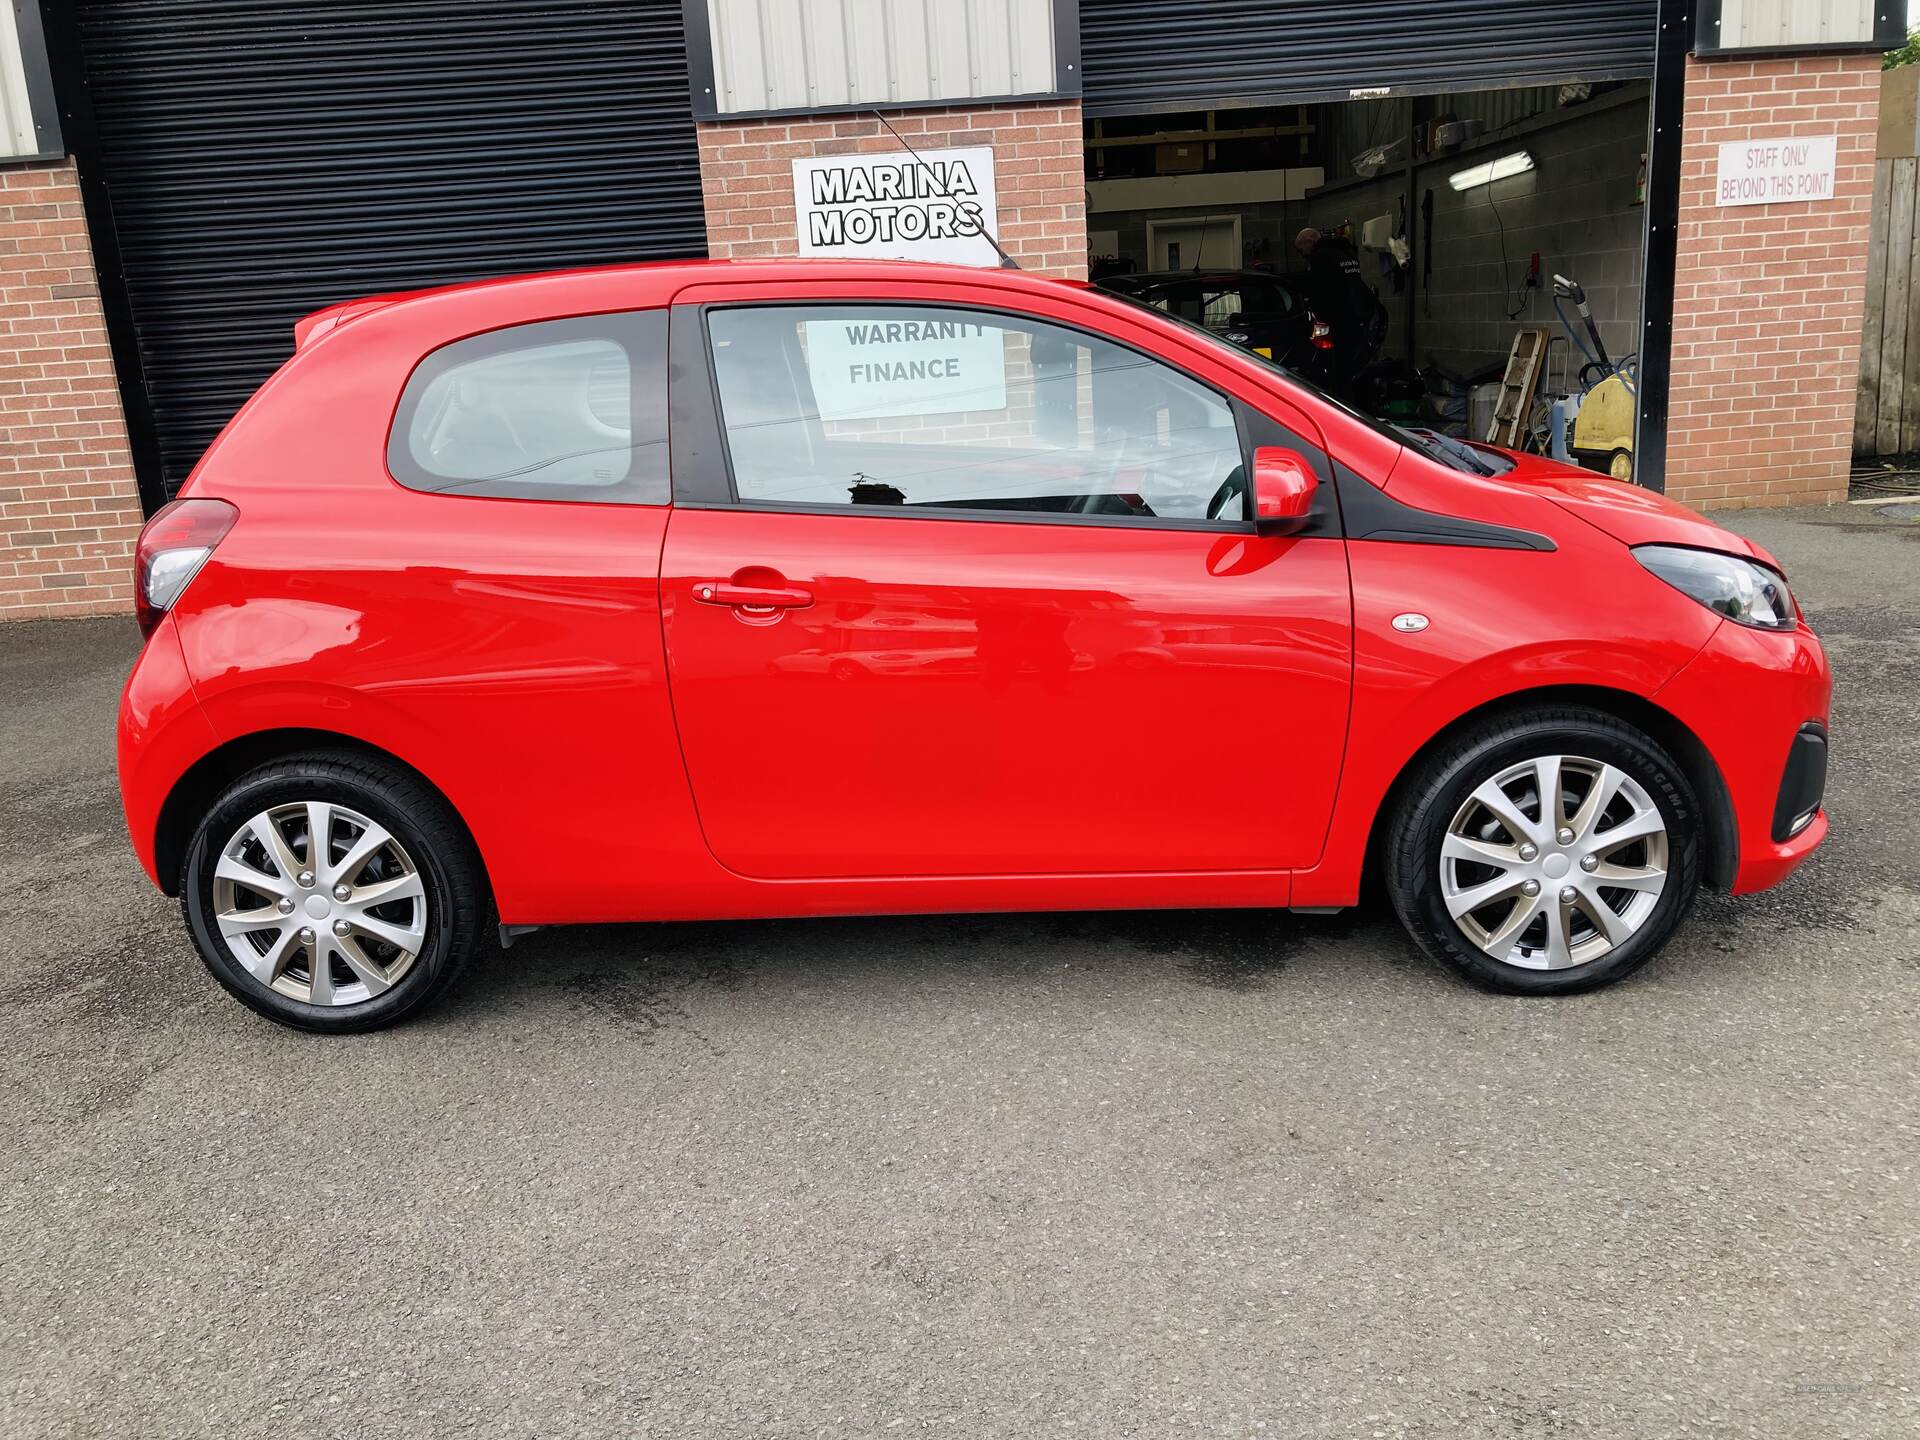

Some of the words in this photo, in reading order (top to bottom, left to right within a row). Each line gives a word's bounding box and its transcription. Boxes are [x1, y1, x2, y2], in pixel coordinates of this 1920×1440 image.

[1747, 147, 1778, 169] STAFF
[1782, 145, 1809, 167] ONLY
[810, 160, 977, 205] MARINA
[1721, 177, 1767, 200] BEYOND
[1770, 175, 1793, 196] THIS
[1799, 172, 1829, 195] POINT
[809, 201, 984, 246] MOTORS
[849, 358, 961, 384] FINANCE
